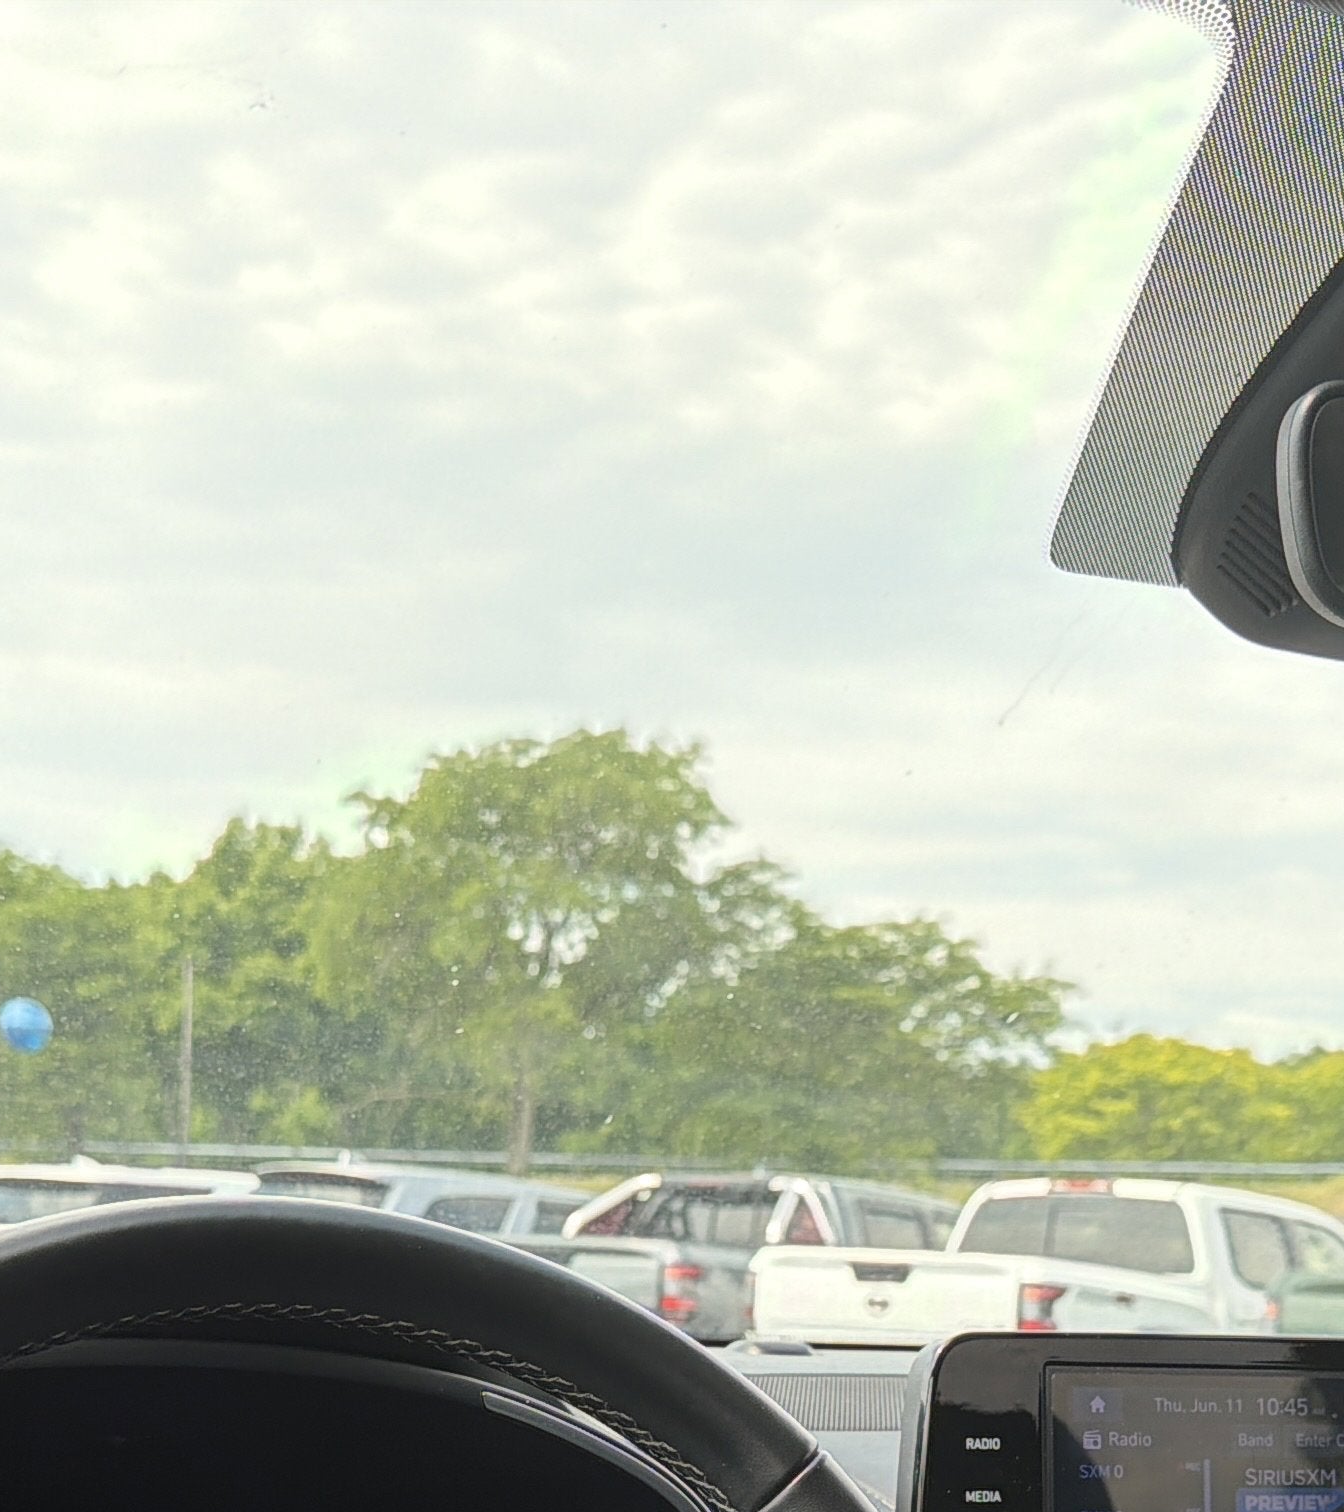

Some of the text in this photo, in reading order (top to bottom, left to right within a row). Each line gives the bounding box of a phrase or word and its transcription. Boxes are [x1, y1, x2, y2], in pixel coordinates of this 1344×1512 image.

[1227, 1398, 1242, 1412] 11
[1256, 1397, 1307, 1416] 10:45
[965, 1437, 1001, 1450] RADIO
[1108, 1430, 1152, 1448] Radio
[1237, 1433, 1274, 1448] Band
[1295, 1433, 1332, 1448] Enter
[1079, 1465, 1110, 1479] SXM
[1244, 1467, 1337, 1486] SIRIUSXM
[965, 1490, 1002, 1503] MEDIA
[1244, 1495, 1338, 1512] PREVIEW
